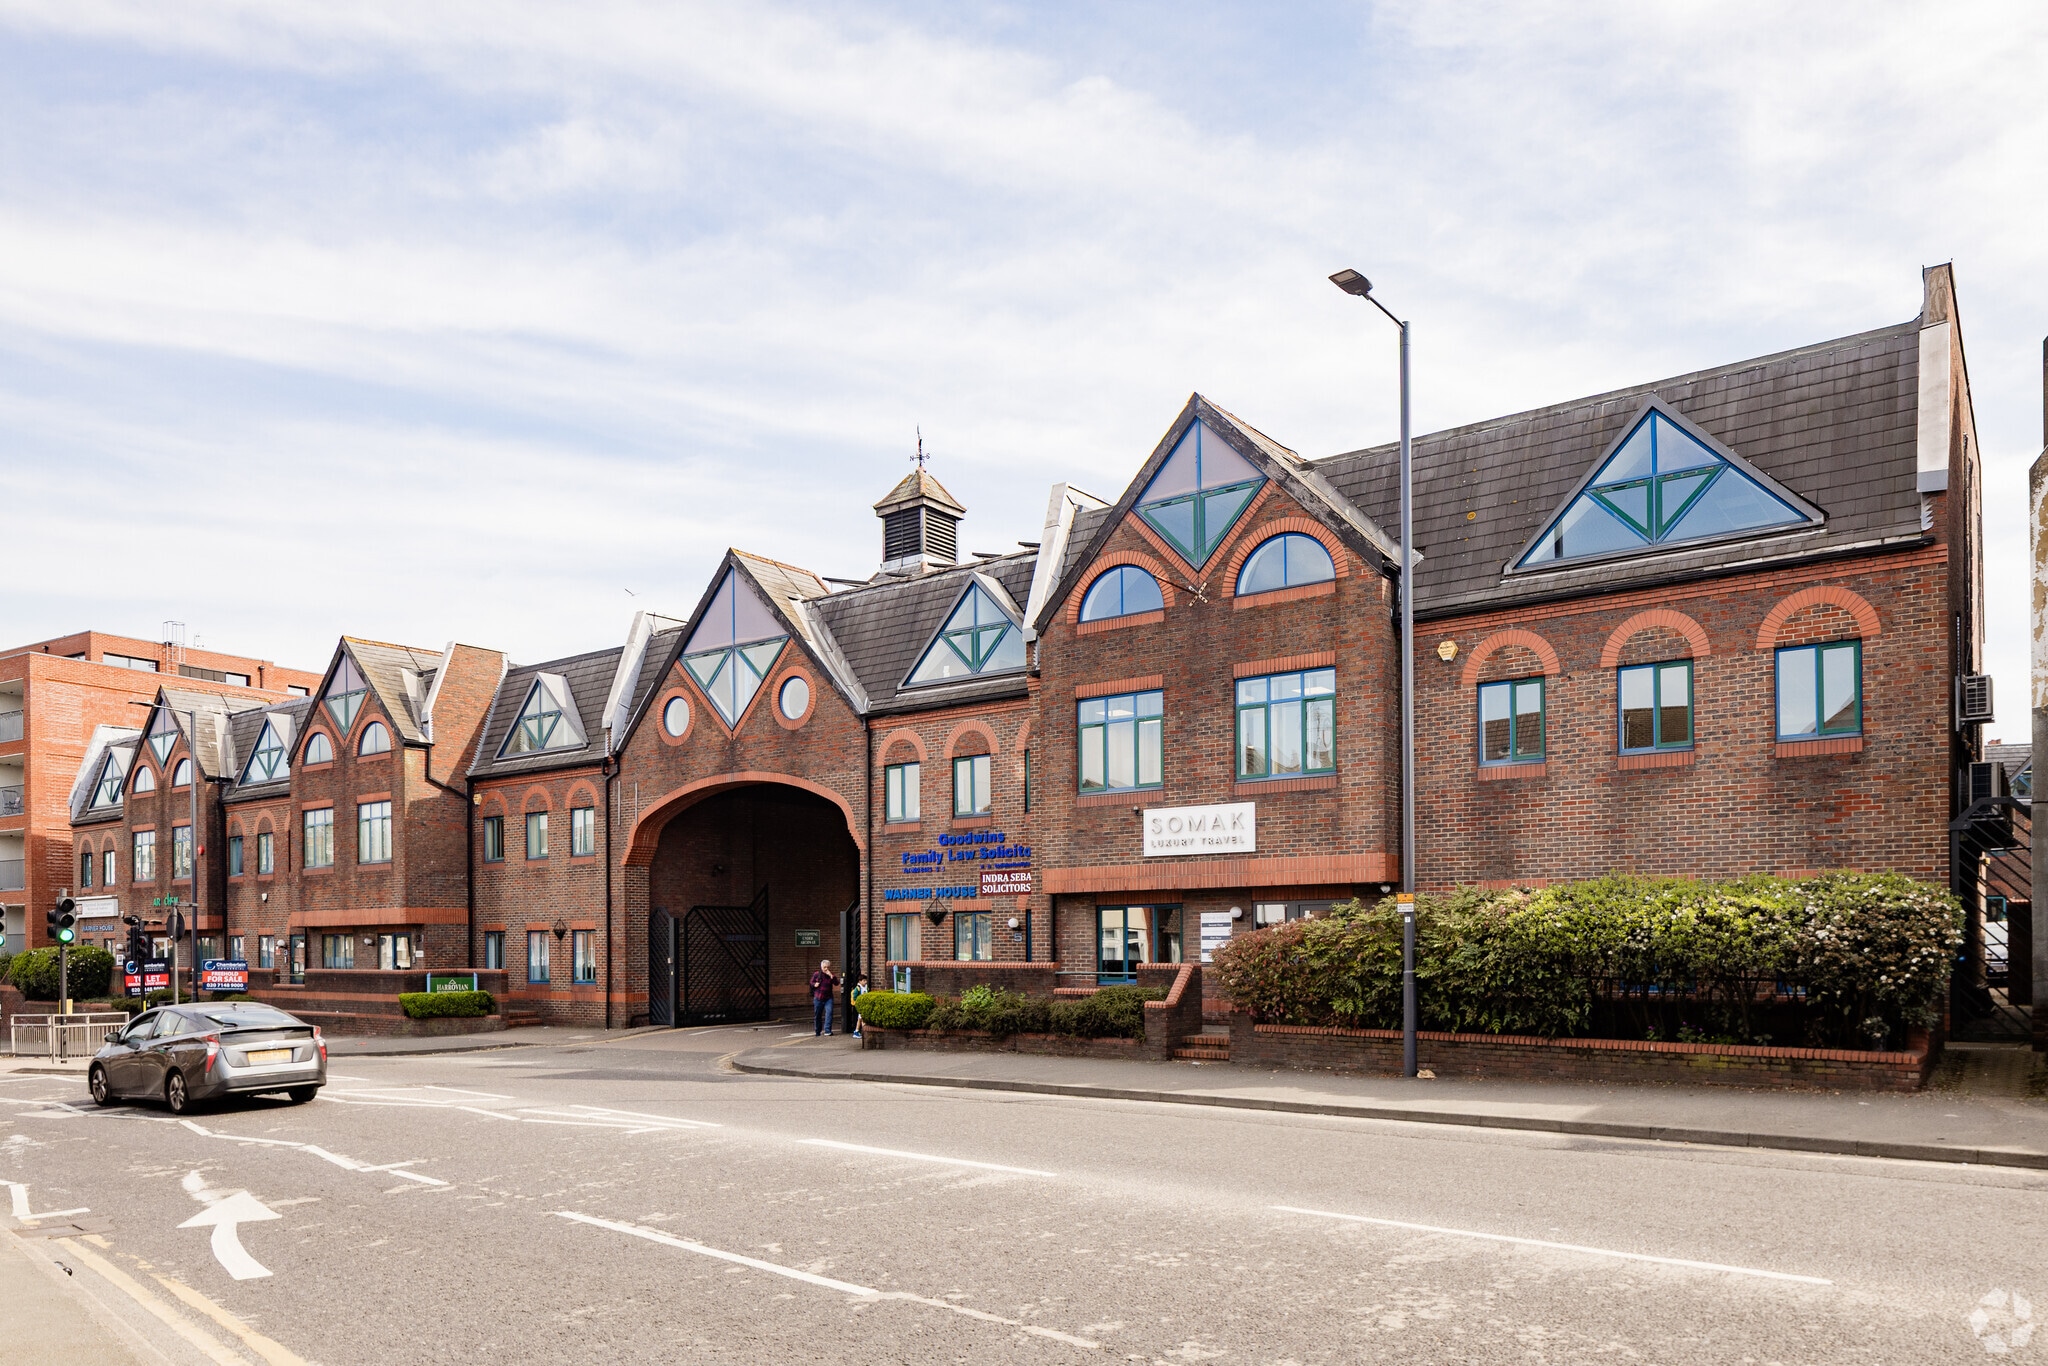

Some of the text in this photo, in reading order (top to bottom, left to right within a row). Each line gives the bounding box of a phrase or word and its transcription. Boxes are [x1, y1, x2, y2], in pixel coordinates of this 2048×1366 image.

[1151, 812, 1245, 835] SOMAK
[938, 830, 1005, 846] Goodwins
[1151, 836, 1245, 849] LUXURY TRAVEL
[902, 849, 943, 865] Family
[948, 848, 976, 862] Law
[982, 873, 1009, 883] INDRA
[884, 886, 977, 900] WARNER HOUSE
[982, 883, 1031, 894] SOLICITORS
[1014, 932, 1023, 942] 5
[146, 974, 161, 982] LET
